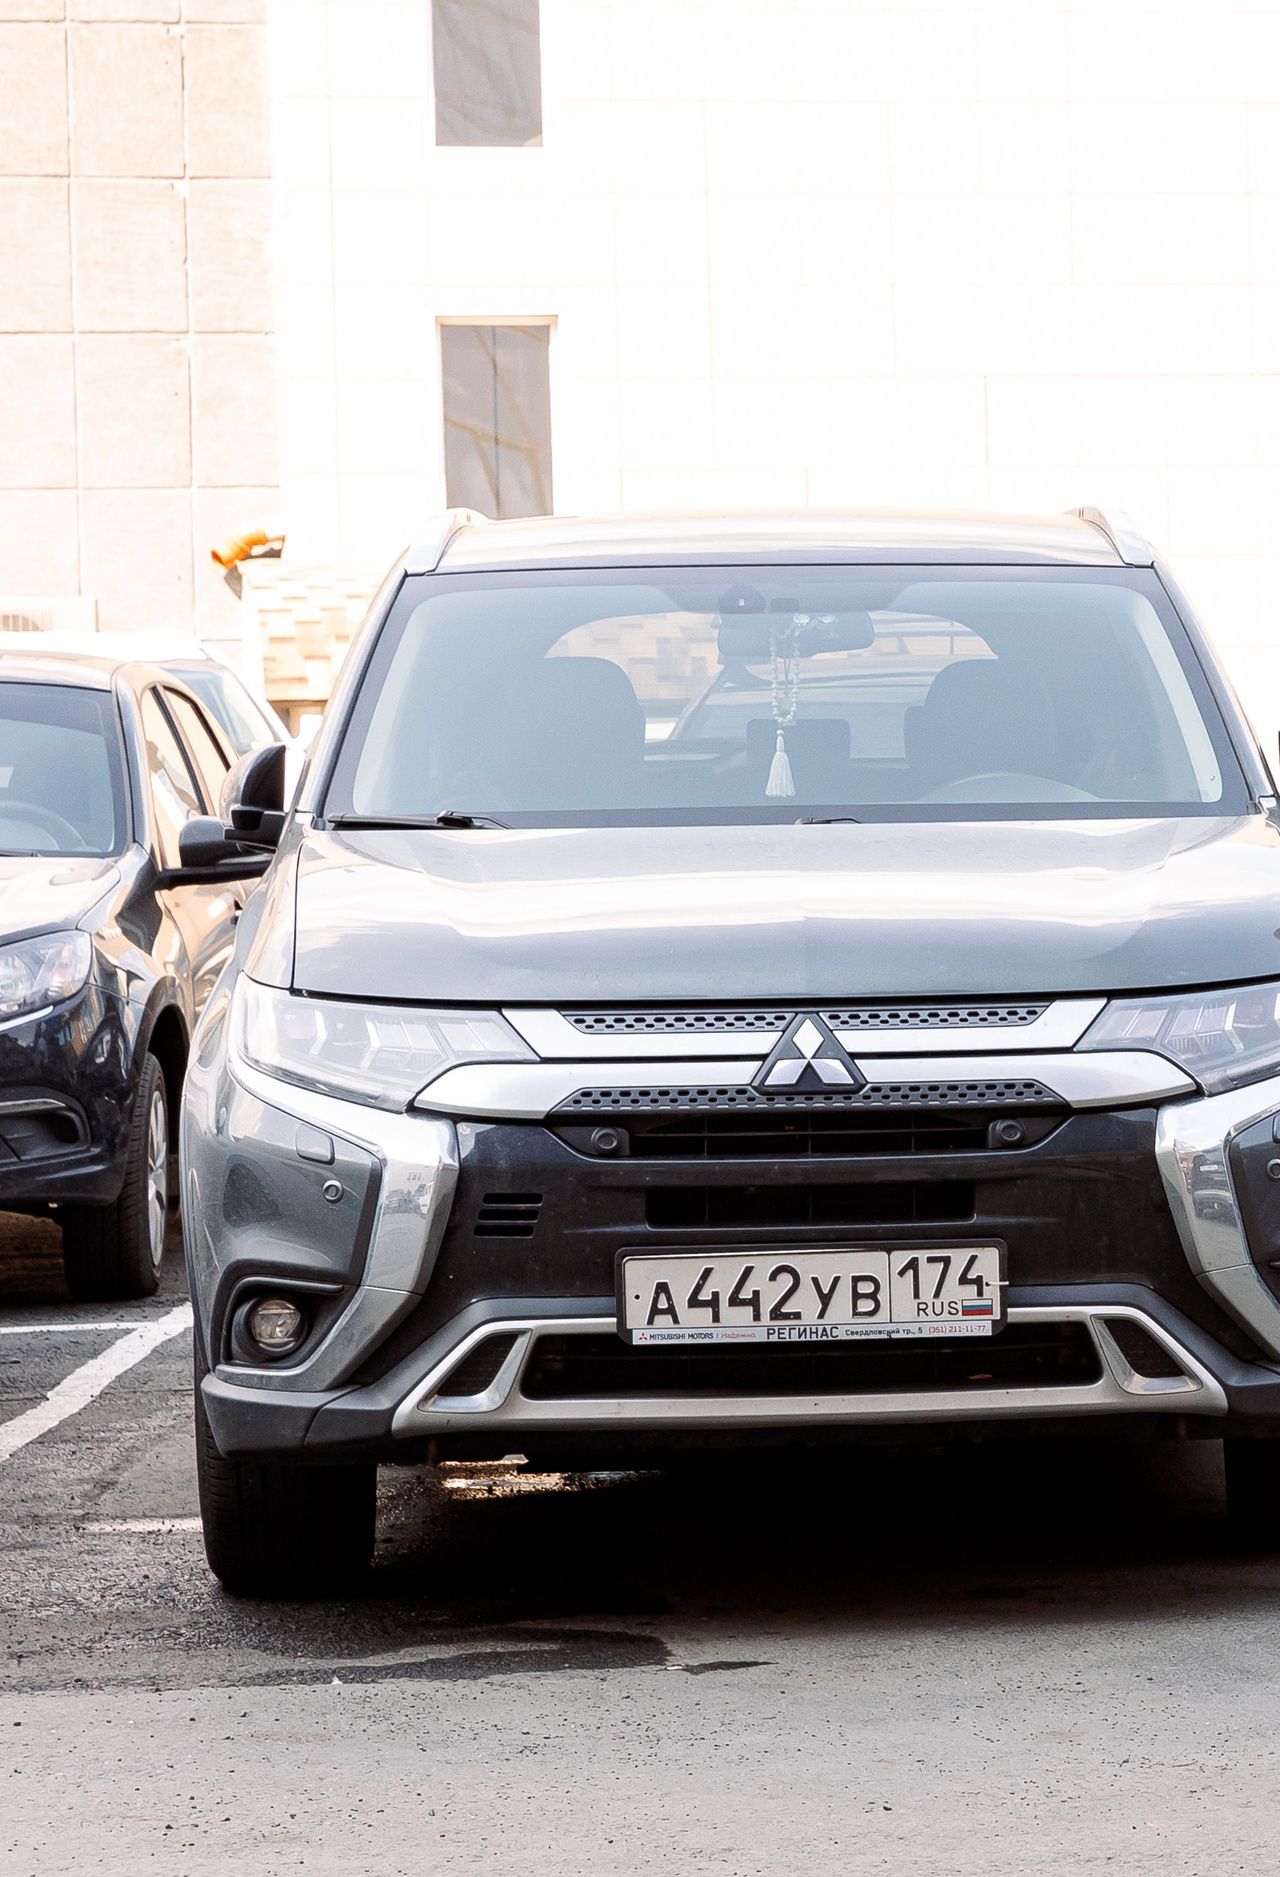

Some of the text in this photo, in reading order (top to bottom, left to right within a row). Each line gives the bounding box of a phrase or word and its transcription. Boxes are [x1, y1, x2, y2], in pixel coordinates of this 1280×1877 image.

[645, 1253, 985, 1326] А442УВ 174
[916, 1300, 960, 1317] RUS
[649, 1333, 685, 1341] MITSUBISHI
[687, 1332, 714, 1340] MOTORS
[766, 1325, 839, 1341] РЕГИНАС
[844, 1327, 901, 1337] Свердловский
[917, 1326, 923, 1334] 5
[928, 1326, 947, 1334] (351)
